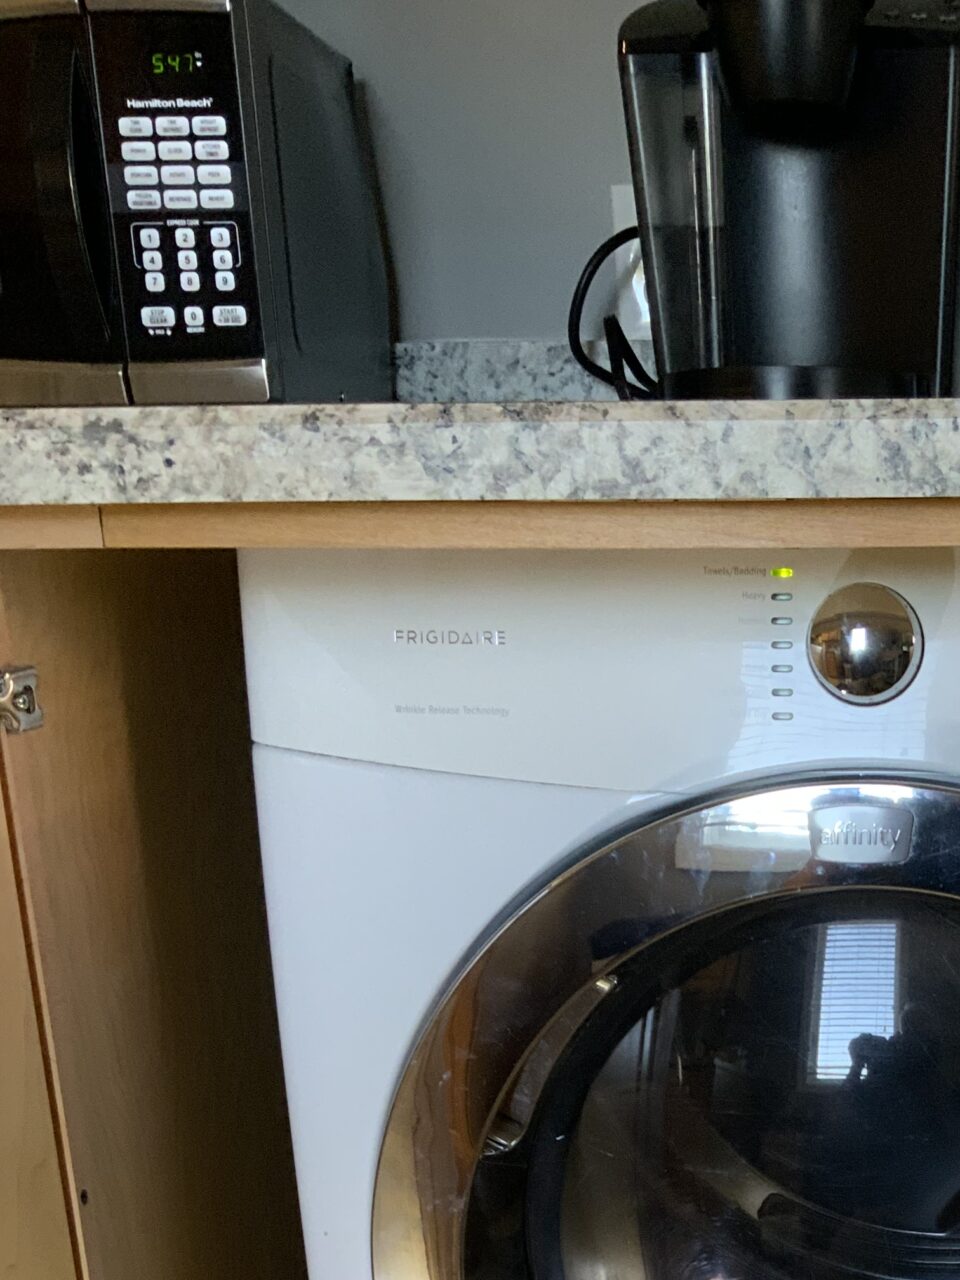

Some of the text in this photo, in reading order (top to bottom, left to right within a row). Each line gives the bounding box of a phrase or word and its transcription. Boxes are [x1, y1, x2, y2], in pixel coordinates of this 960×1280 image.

[126, 98, 176, 109] Hamilton
[147, 233, 153, 244] 1
[182, 233, 189, 243] 2
[217, 232, 224, 242] 3
[149, 256, 156, 265] 4
[184, 255, 191, 265] 5
[219, 255, 226, 265] 6
[151, 276, 158, 286] 7
[187, 276, 193, 286] 8
[221, 276, 228, 286] 9
[190, 311, 197, 321] 0
[394, 629, 507, 646] FRIGIDAIRE
[428, 705, 460, 715] Release
[463, 705, 510, 718] Technology
[820, 820, 901, 851] affinity
